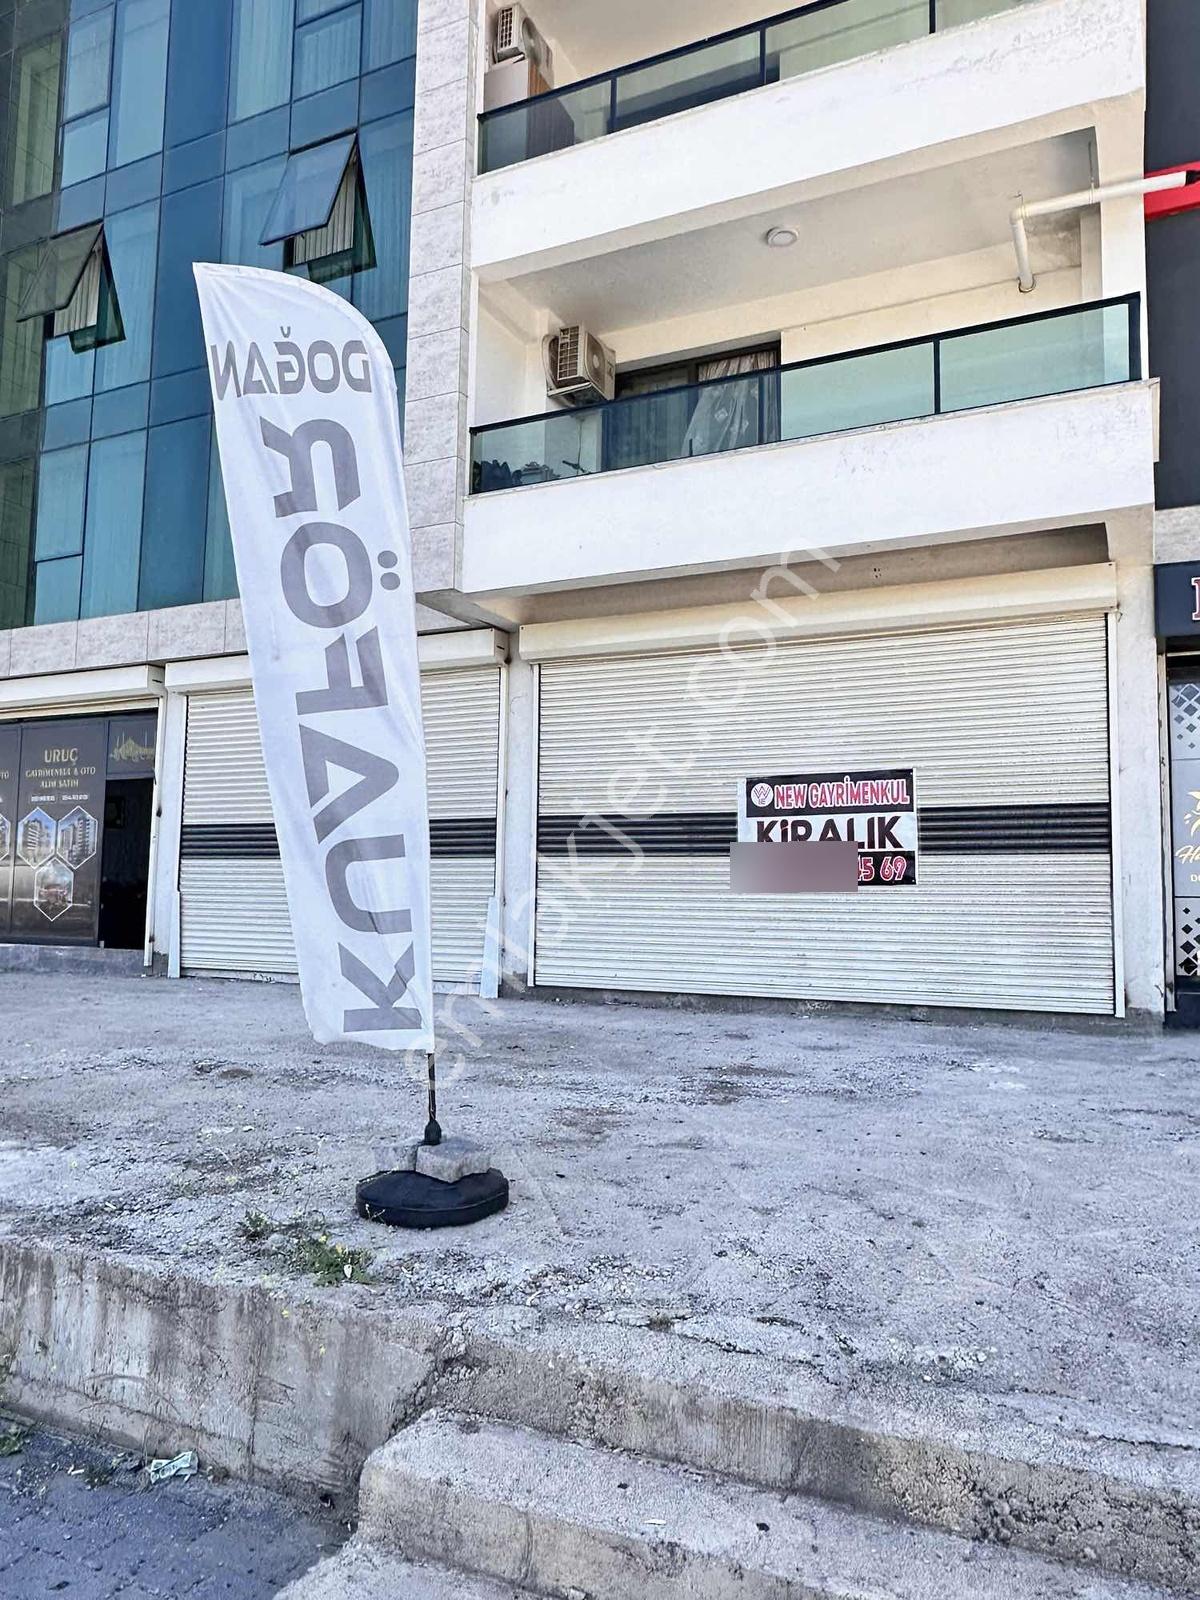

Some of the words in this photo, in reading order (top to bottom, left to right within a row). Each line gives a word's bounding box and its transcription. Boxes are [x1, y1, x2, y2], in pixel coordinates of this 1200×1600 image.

[44, 748, 79, 766] URUÇ
[774, 784, 808, 810] NEW
[809, 775, 911, 809] GAYRİMENKUL
[880, 855, 907, 882] 69
